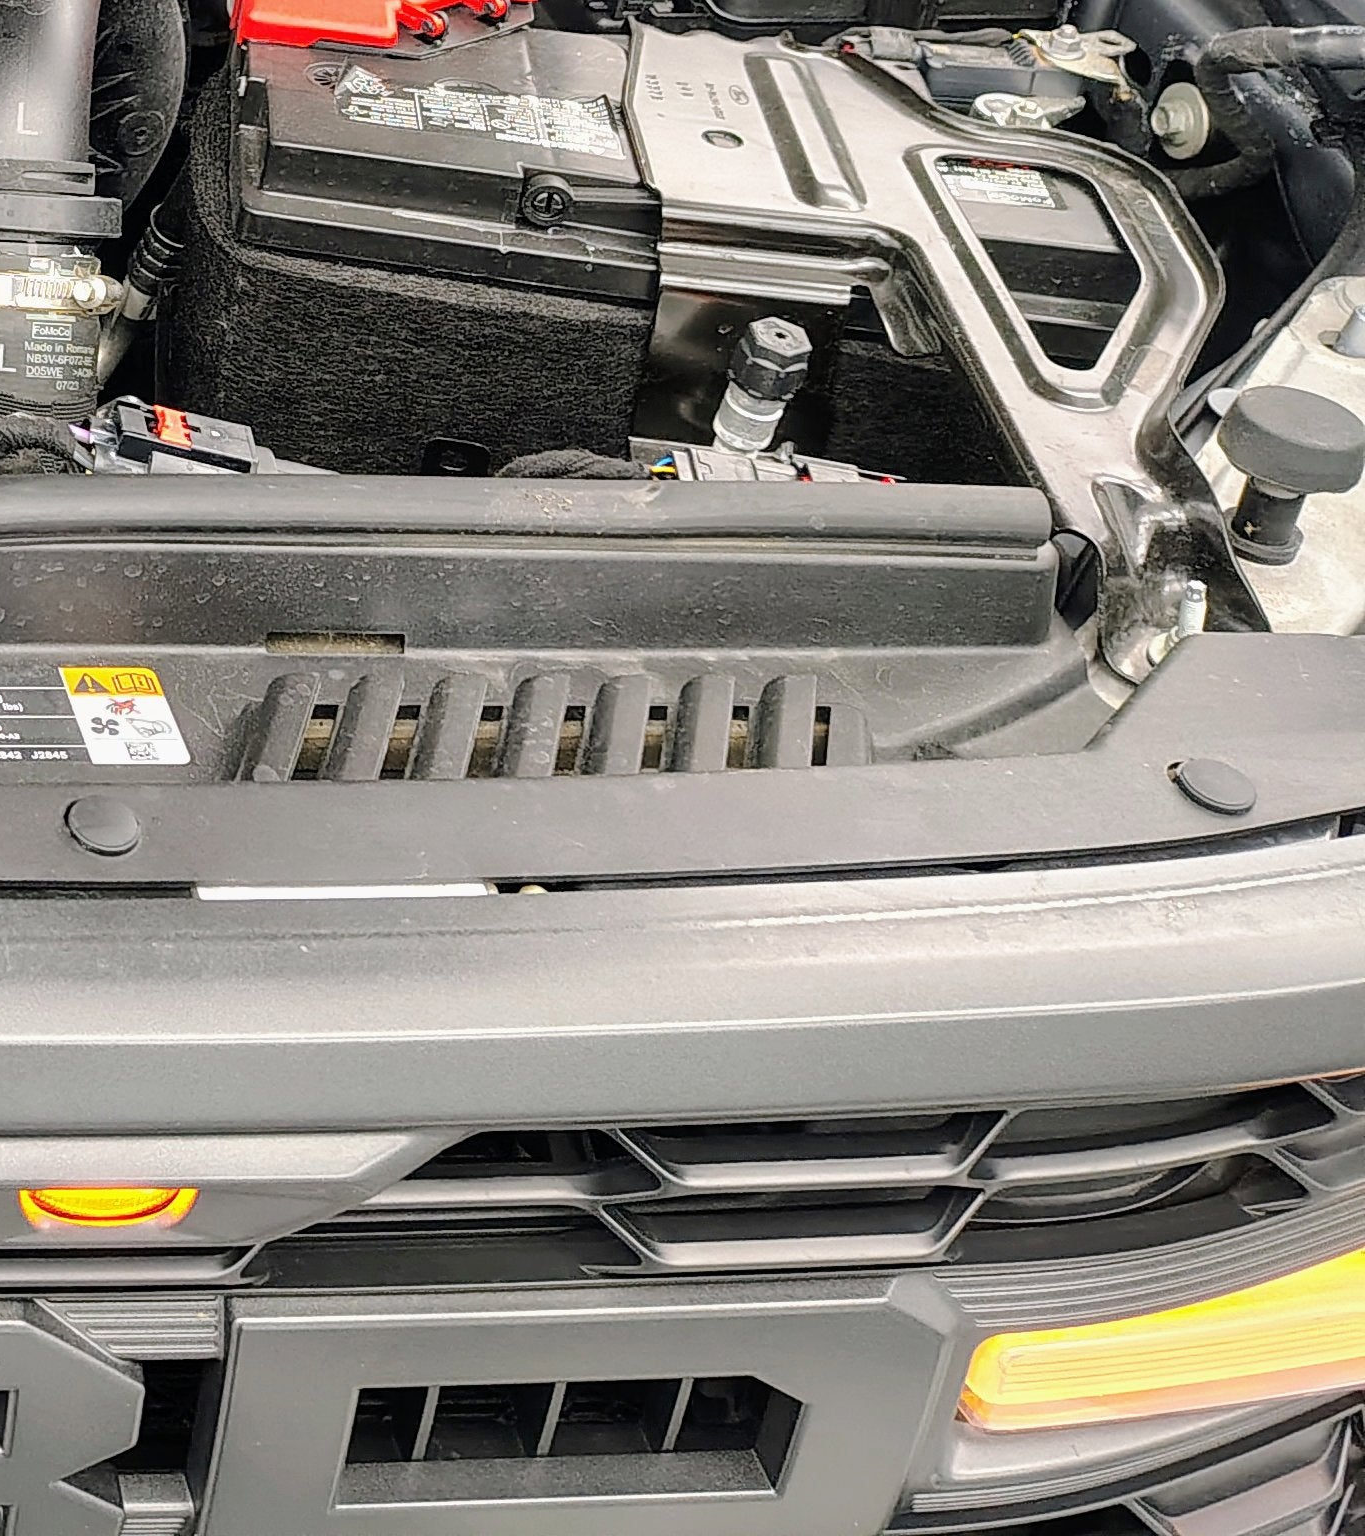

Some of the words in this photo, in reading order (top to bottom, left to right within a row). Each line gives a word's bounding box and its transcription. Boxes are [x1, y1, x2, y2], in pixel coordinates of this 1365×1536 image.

[17, 102, 39, 136] L
[33, 325, 71, 337] FoMoCo
[24, 341, 53, 352] Made
[54, 343, 64, 353] in
